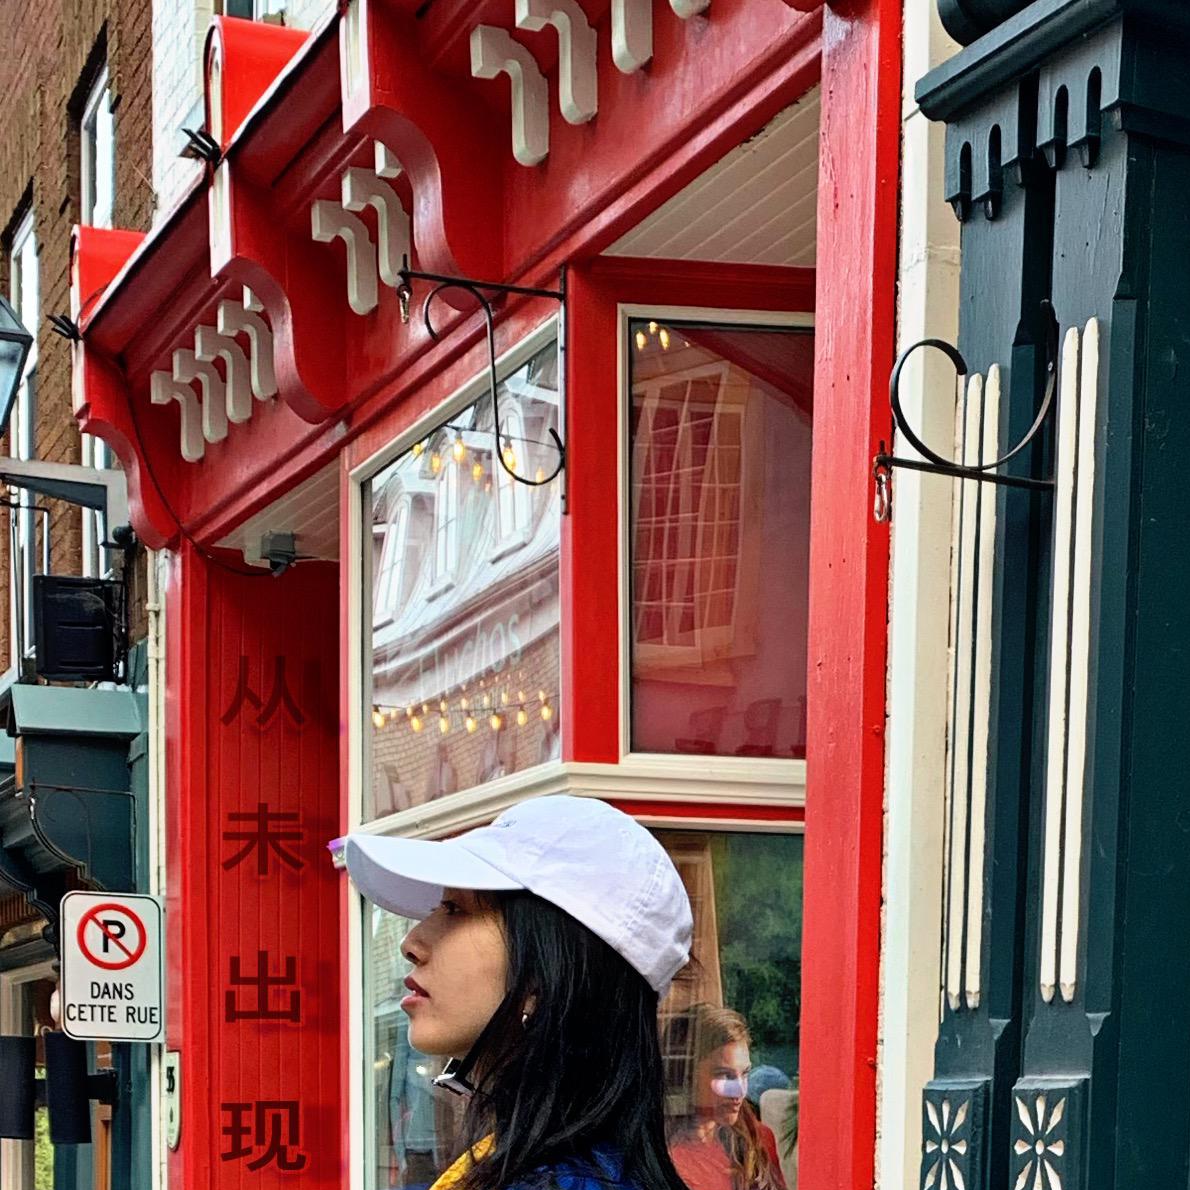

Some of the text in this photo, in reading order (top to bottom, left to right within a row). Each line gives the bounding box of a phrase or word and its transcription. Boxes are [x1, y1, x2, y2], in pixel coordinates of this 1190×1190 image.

[90, 981, 135, 1001] DANS
[66, 1003, 159, 1024] CETTE RUE
